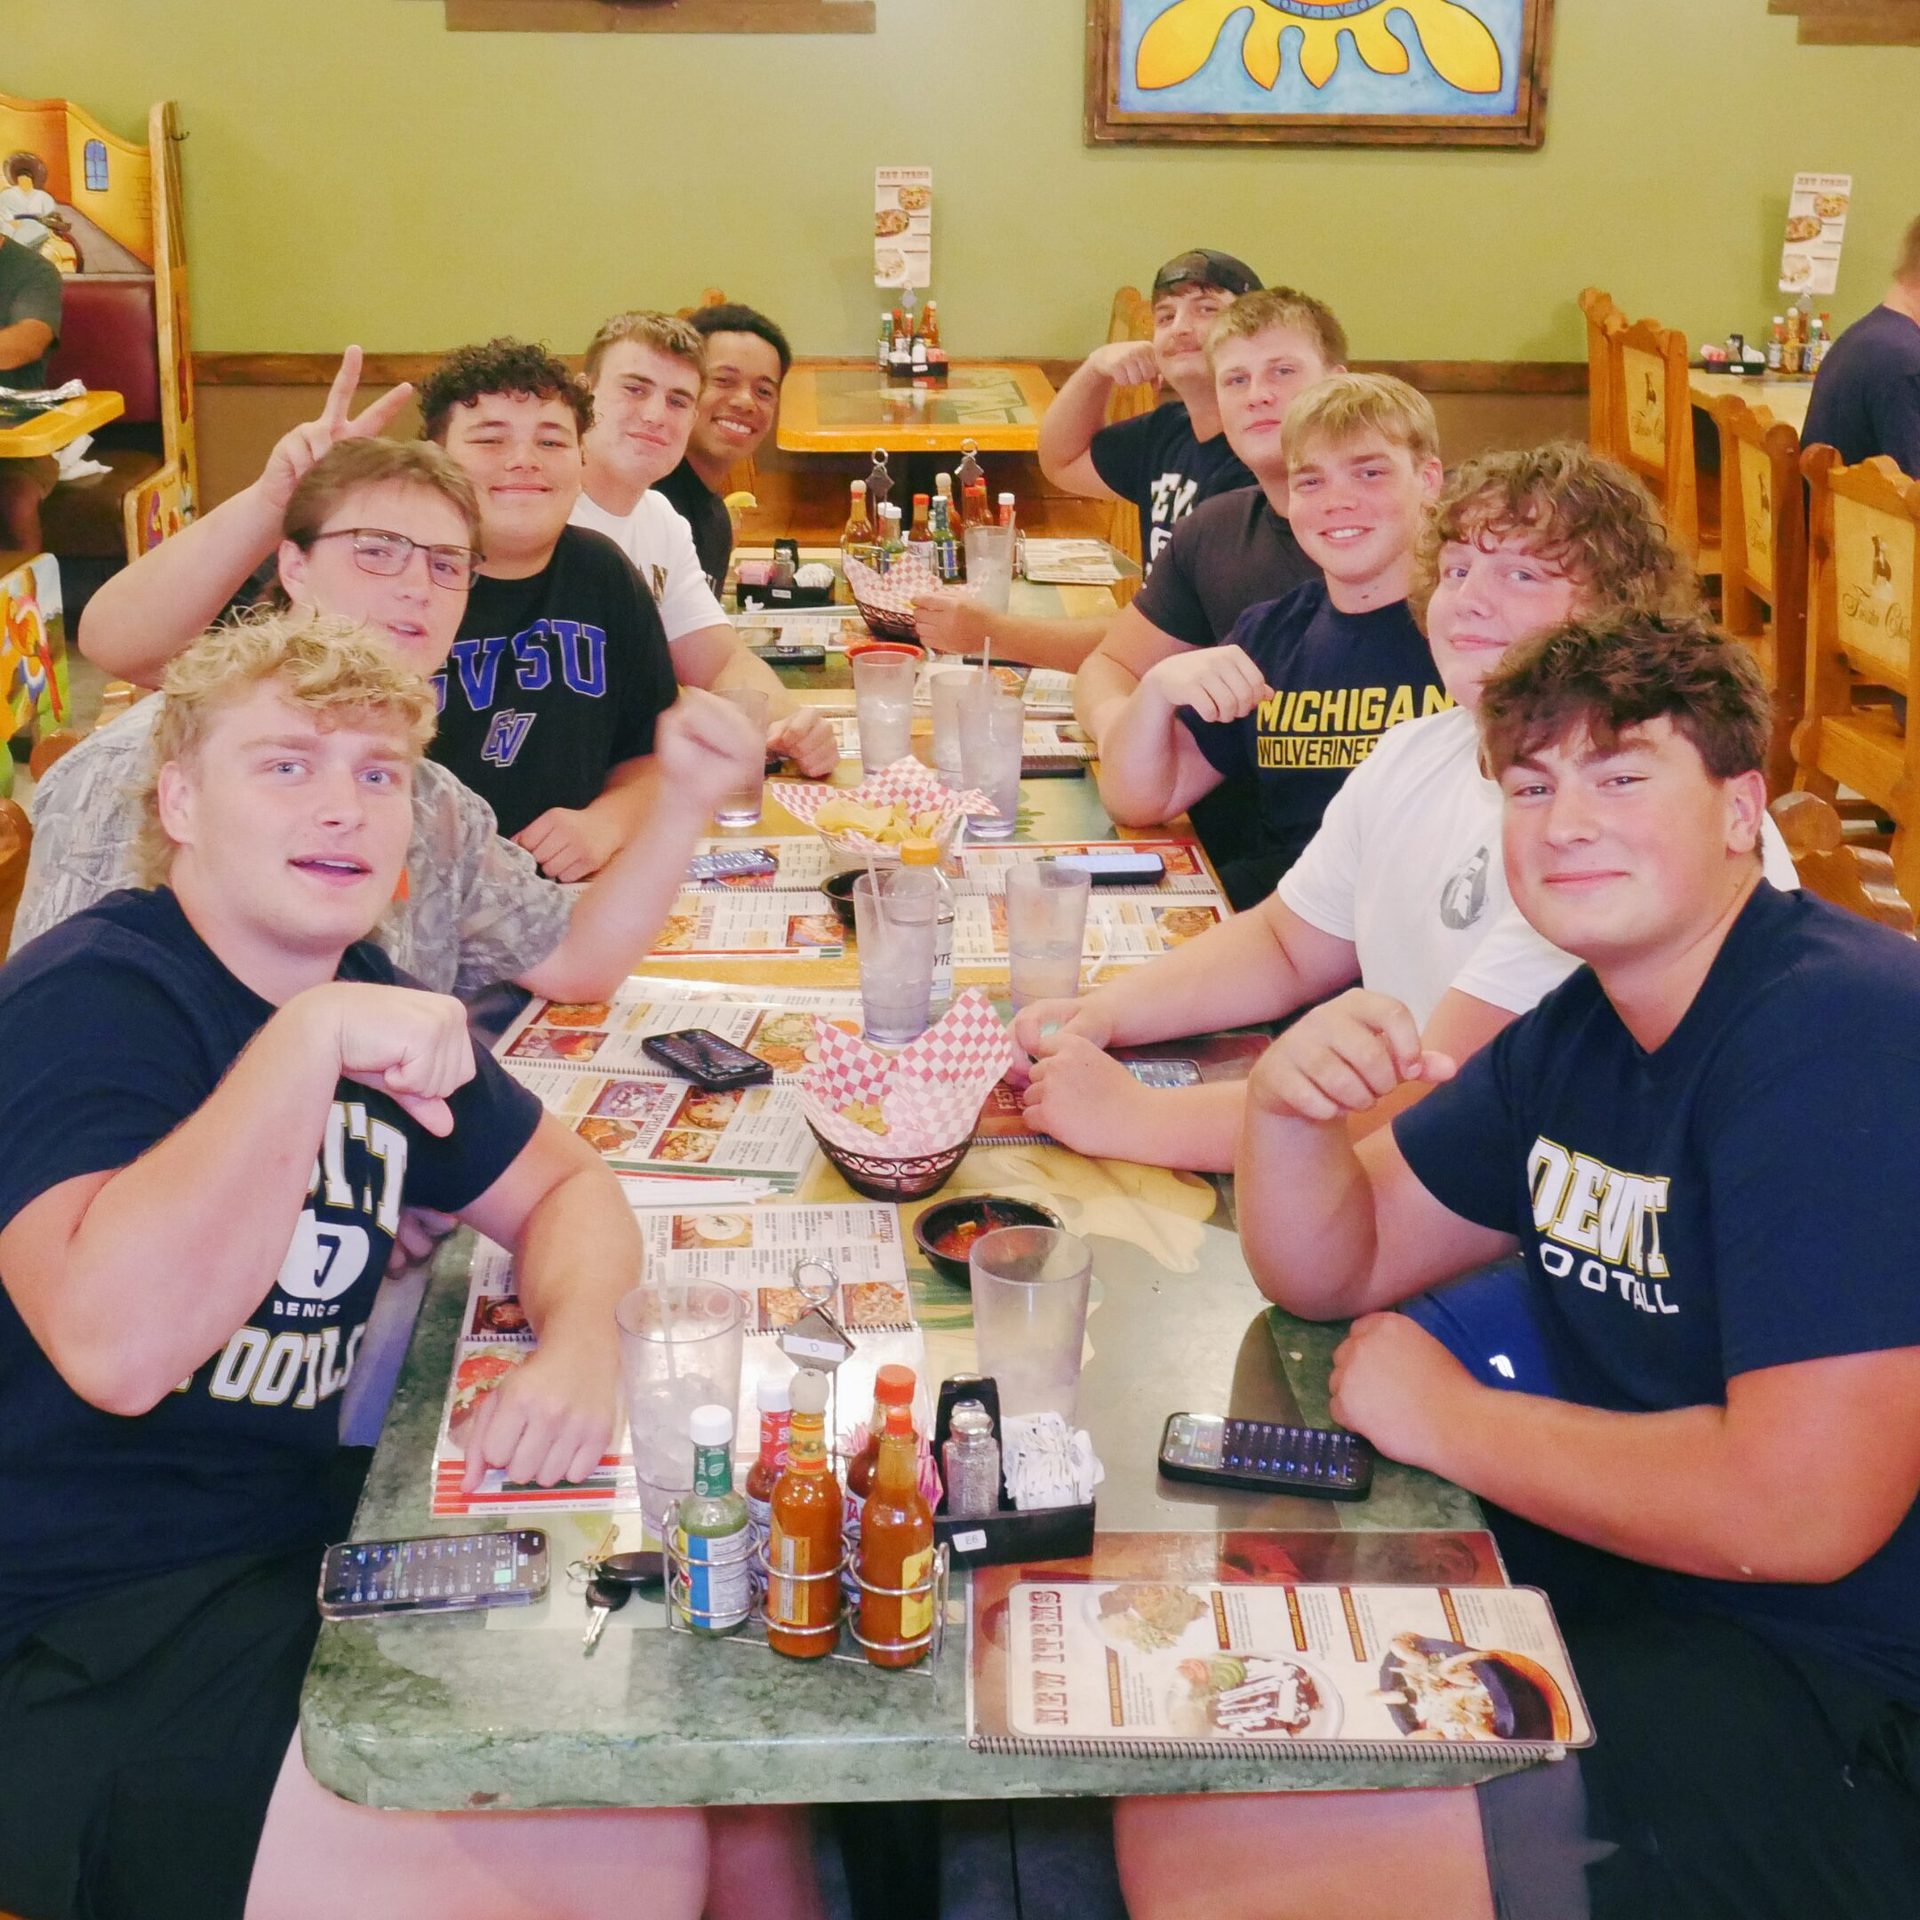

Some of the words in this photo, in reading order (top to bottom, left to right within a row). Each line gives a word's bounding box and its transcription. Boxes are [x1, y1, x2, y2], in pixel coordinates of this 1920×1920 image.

[1257, 685, 1456, 733] MICHIGAN
[1258, 738, 1379, 766] WOLVERINES
[655, 1093, 678, 1112] HOUSE
[1030, 1590, 1064, 1664] ITEMS
[1033, 1670, 1069, 1726] NEW
